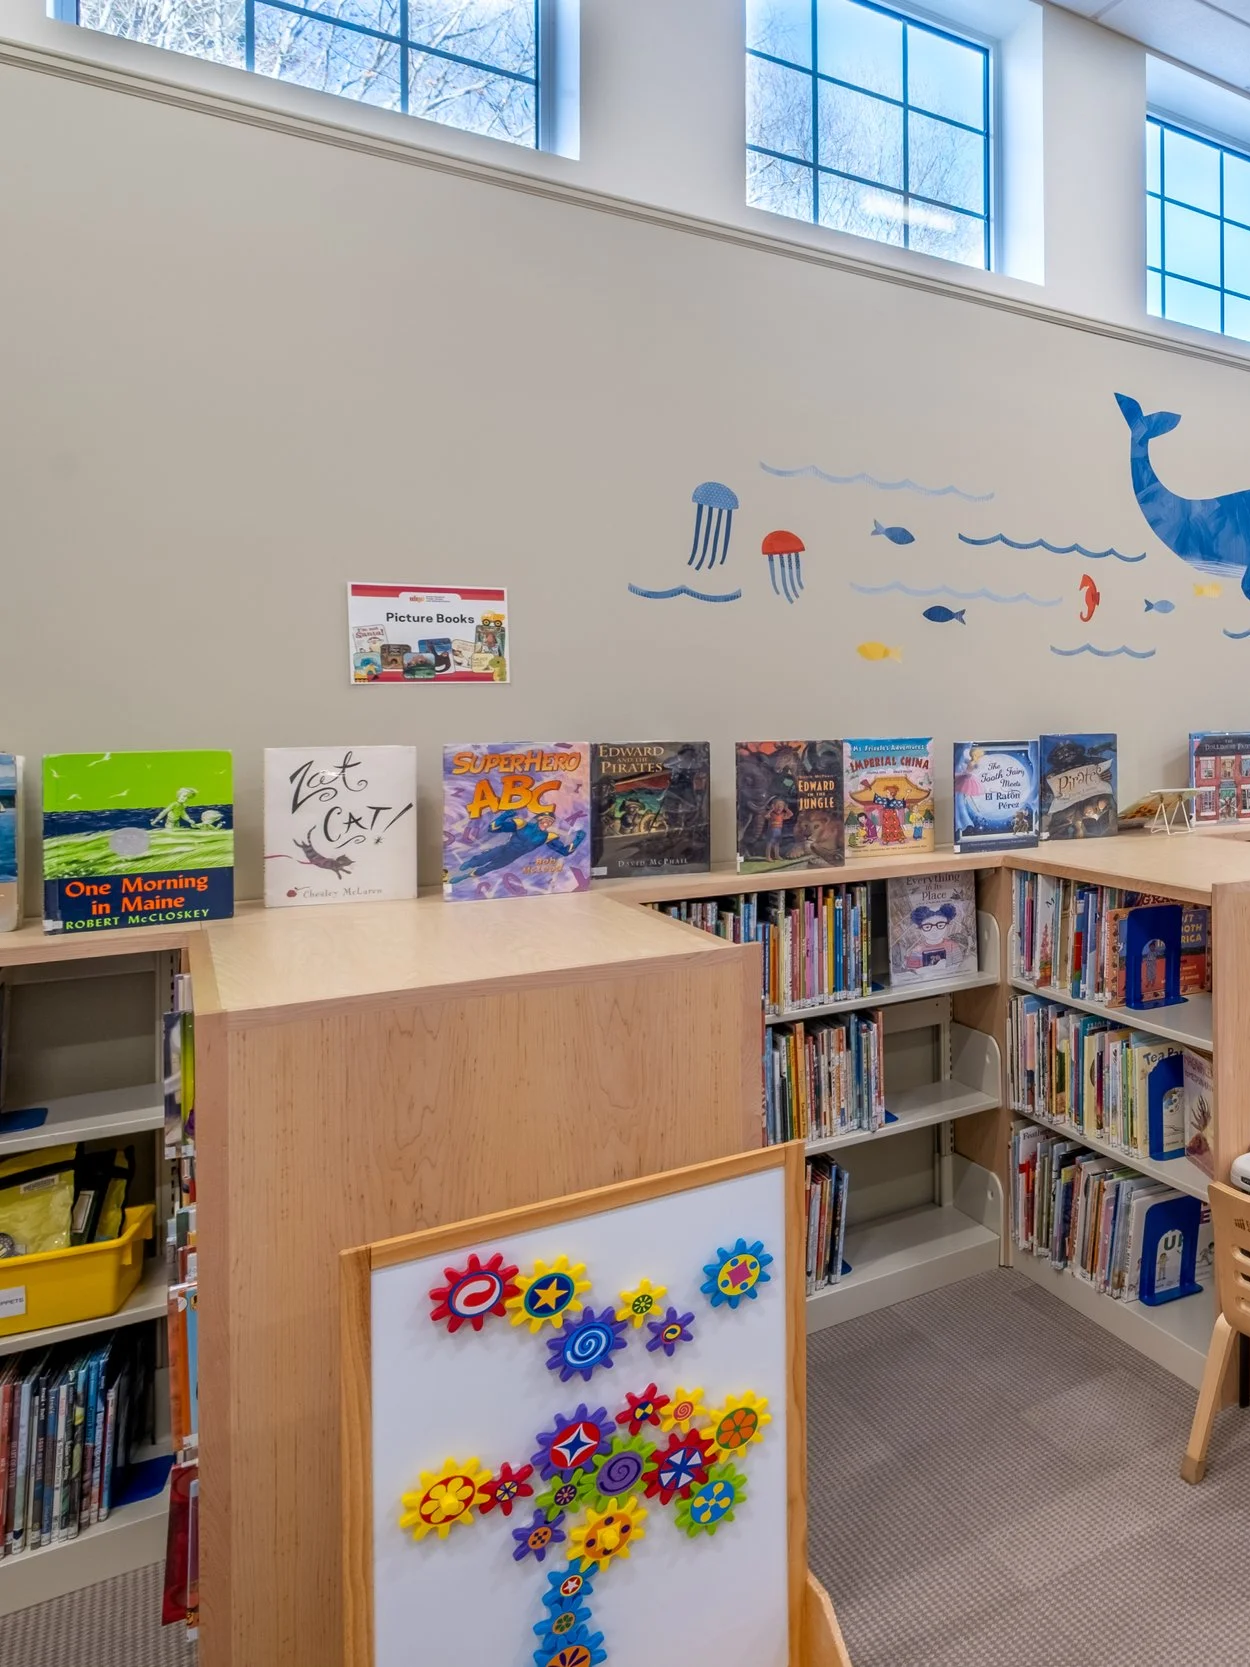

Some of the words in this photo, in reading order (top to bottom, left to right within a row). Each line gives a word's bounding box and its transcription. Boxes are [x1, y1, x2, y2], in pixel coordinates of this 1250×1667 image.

[386, 612, 433, 623] Picture
[436, 613, 474, 624] Books
[599, 745, 665, 757] EDWARD
[452, 750, 582, 774] SUPERHERO
[601, 761, 664, 774] PIRATES
[850, 756, 897, 773] IMPERIAL
[900, 756, 930, 770] CHINA
[988, 762, 1001, 771] The
[981, 770, 1003, 783] Tooth
[1006, 766, 1025, 777] Fairy
[798, 780, 835, 792] EDWARD
[1000, 778, 1021, 787] Meets
[466, 775, 562, 820] ABC
[985, 792, 993, 800] El
[799, 797, 835, 811] JUNGLE
[906, 872, 961, 885] Everything
[65, 881, 111, 898] One
[121, 874, 209, 894] Morning
[343, 887, 383, 897] McLaren
[922, 891, 947, 901] Place
[91, 900, 111, 915] in
[121, 895, 185, 912] Maine
[65, 916, 120, 930] ROBERT
[127, 908, 210, 925] McCLOSKEY
[1181, 924, 1203, 933] OTH
[1181, 934, 1202, 943] RICA
[1143, 1051, 1165, 1065] Tea
